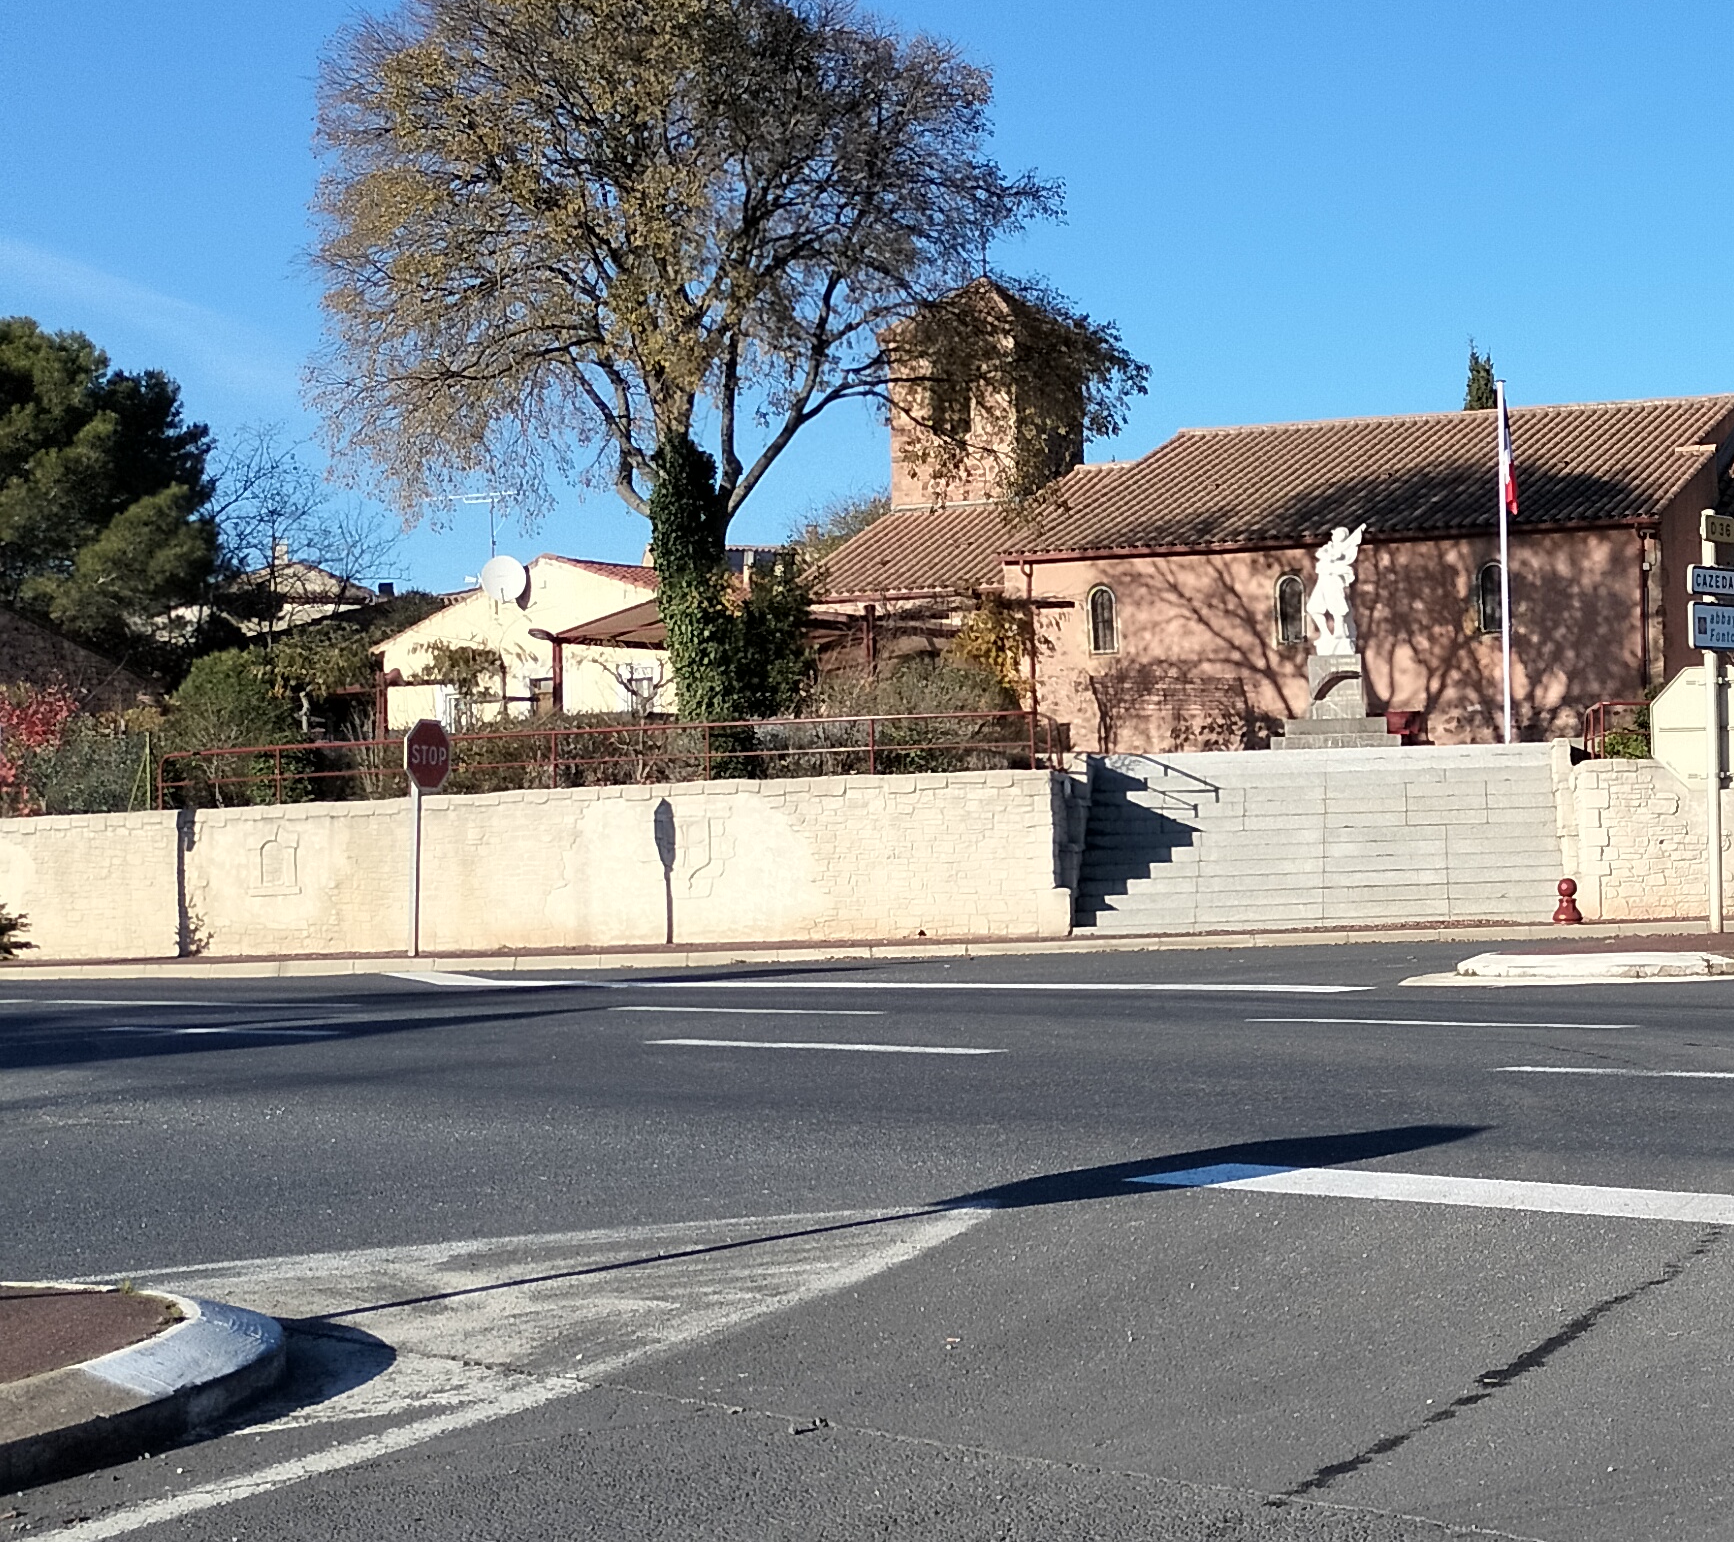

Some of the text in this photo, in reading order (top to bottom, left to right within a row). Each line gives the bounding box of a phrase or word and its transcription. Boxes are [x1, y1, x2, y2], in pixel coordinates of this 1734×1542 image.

[1710, 521, 1731, 537] D 36
[411, 744, 447, 765] STOP
